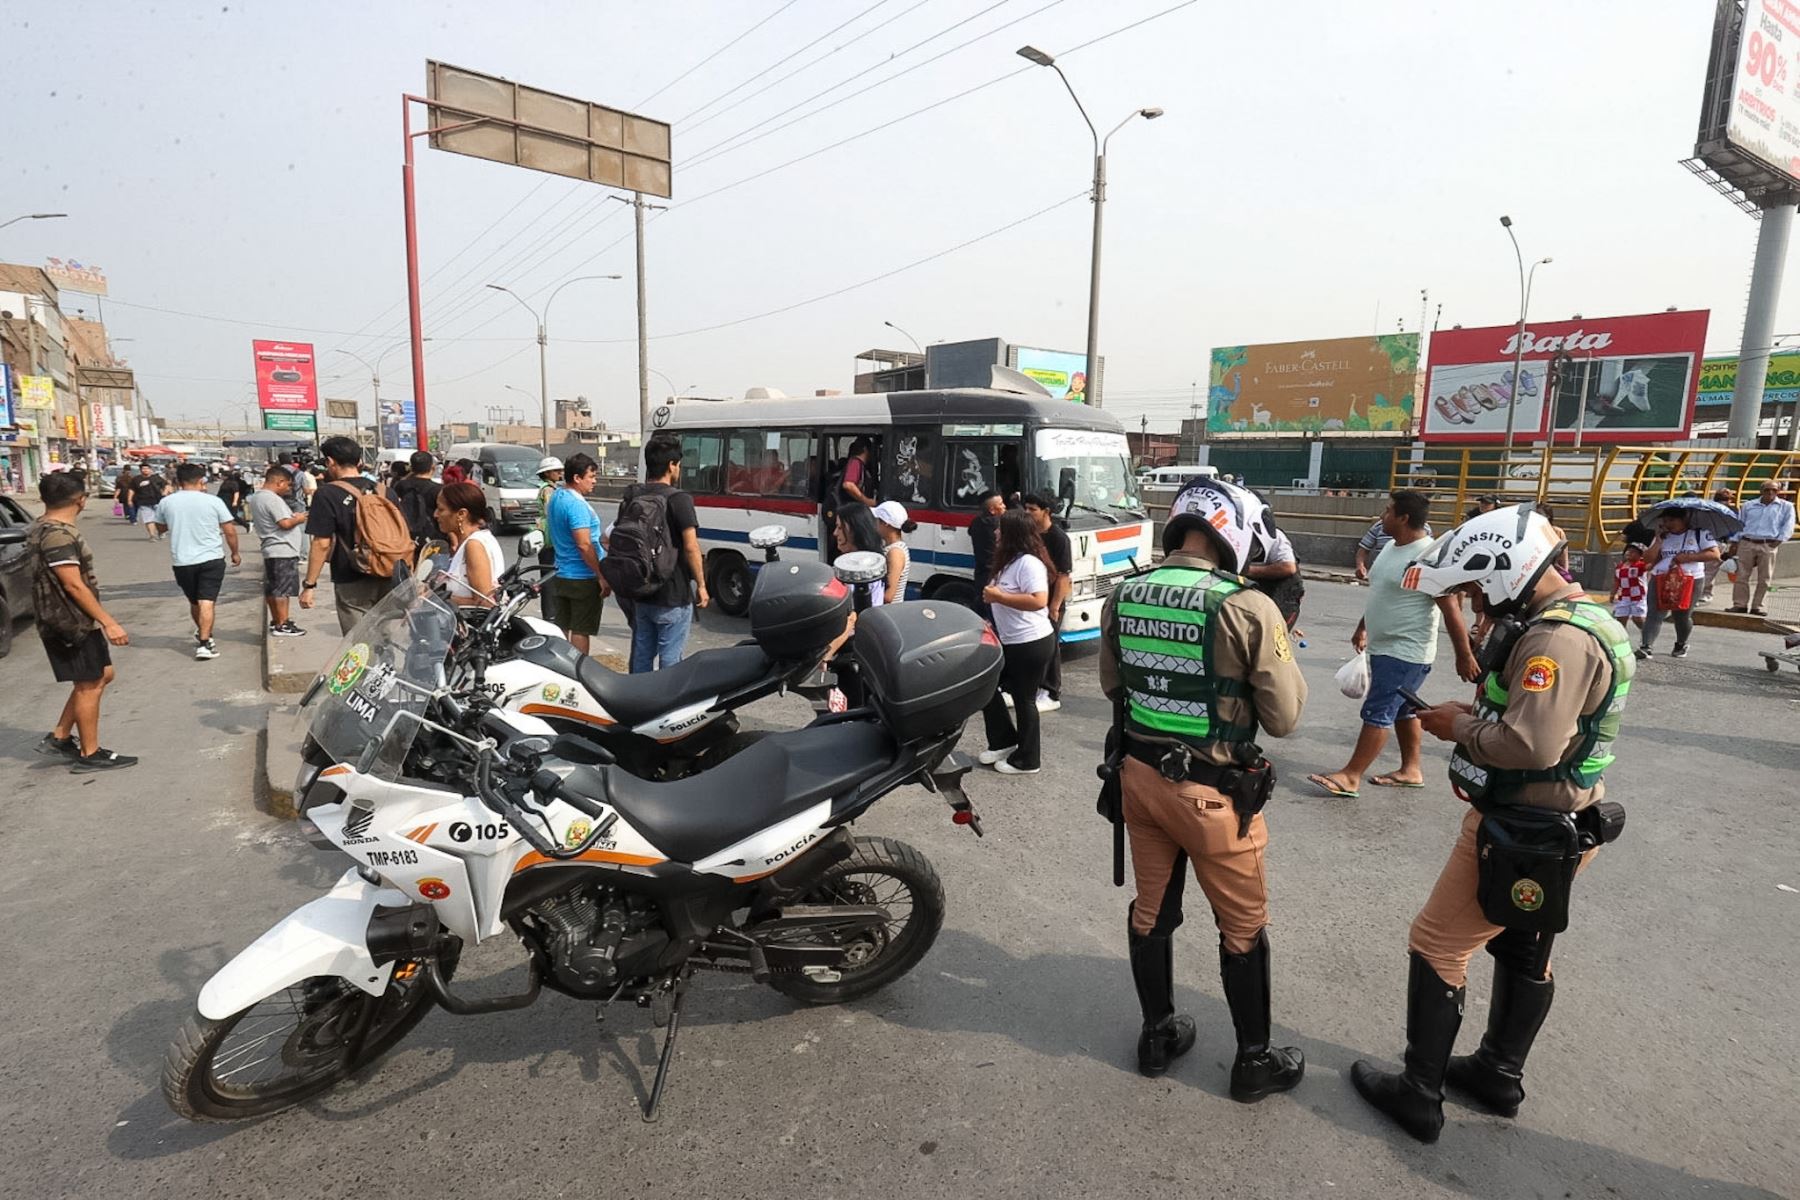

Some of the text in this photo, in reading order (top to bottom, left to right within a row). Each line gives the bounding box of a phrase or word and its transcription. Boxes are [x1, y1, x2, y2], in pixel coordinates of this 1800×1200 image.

[1760, 12, 1782, 42] Hasta
[1500, 329, 1613, 354] Bata
[1080, 536, 1088, 558] V
[1452, 532, 1513, 566] TRANSITO
[1119, 582, 1205, 612] POLICIA
[1119, 616, 1200, 642] TRANSITO
[345, 690, 377, 723] LIMA
[343, 836, 380, 846] HONDA
[475, 823, 509, 840] 105
[366, 849, 419, 866] TMP-6183
[764, 833, 817, 866] POLICÍA
